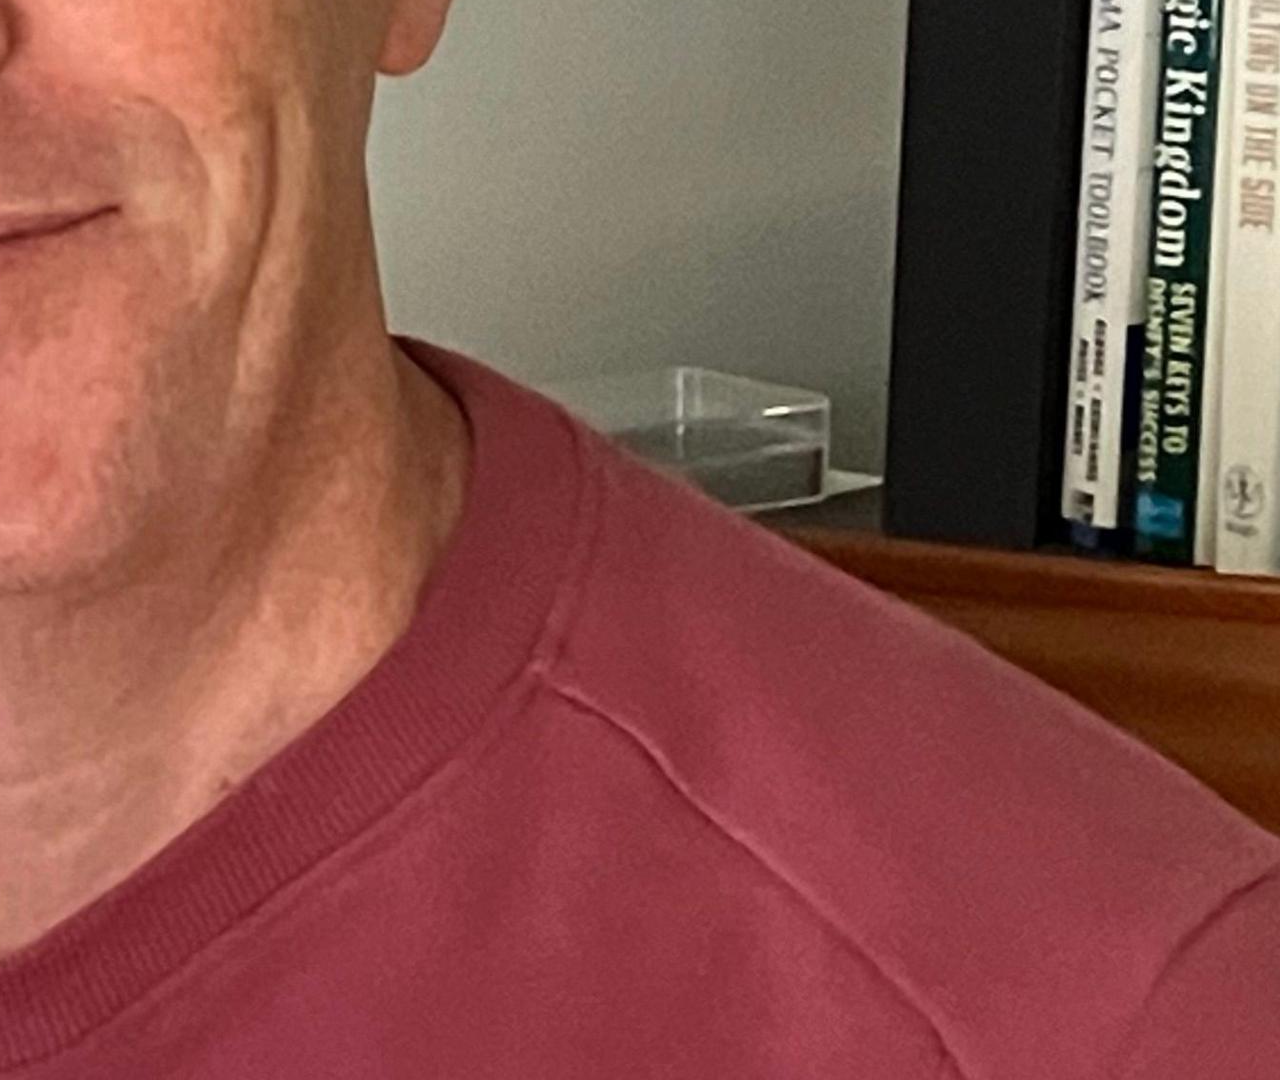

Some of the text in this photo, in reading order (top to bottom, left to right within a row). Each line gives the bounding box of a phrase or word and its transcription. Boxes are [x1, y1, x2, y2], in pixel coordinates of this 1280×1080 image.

[1090, 46, 1120, 161] POCKET
[1240, 124, 1279, 172] THE
[1152, 67, 1208, 267] Kingdom
[1238, 176, 1276, 235] SIDE
[1161, 281, 1198, 455] SEVEN KEYS TO
[1135, 388, 1161, 483] SUCCESS
